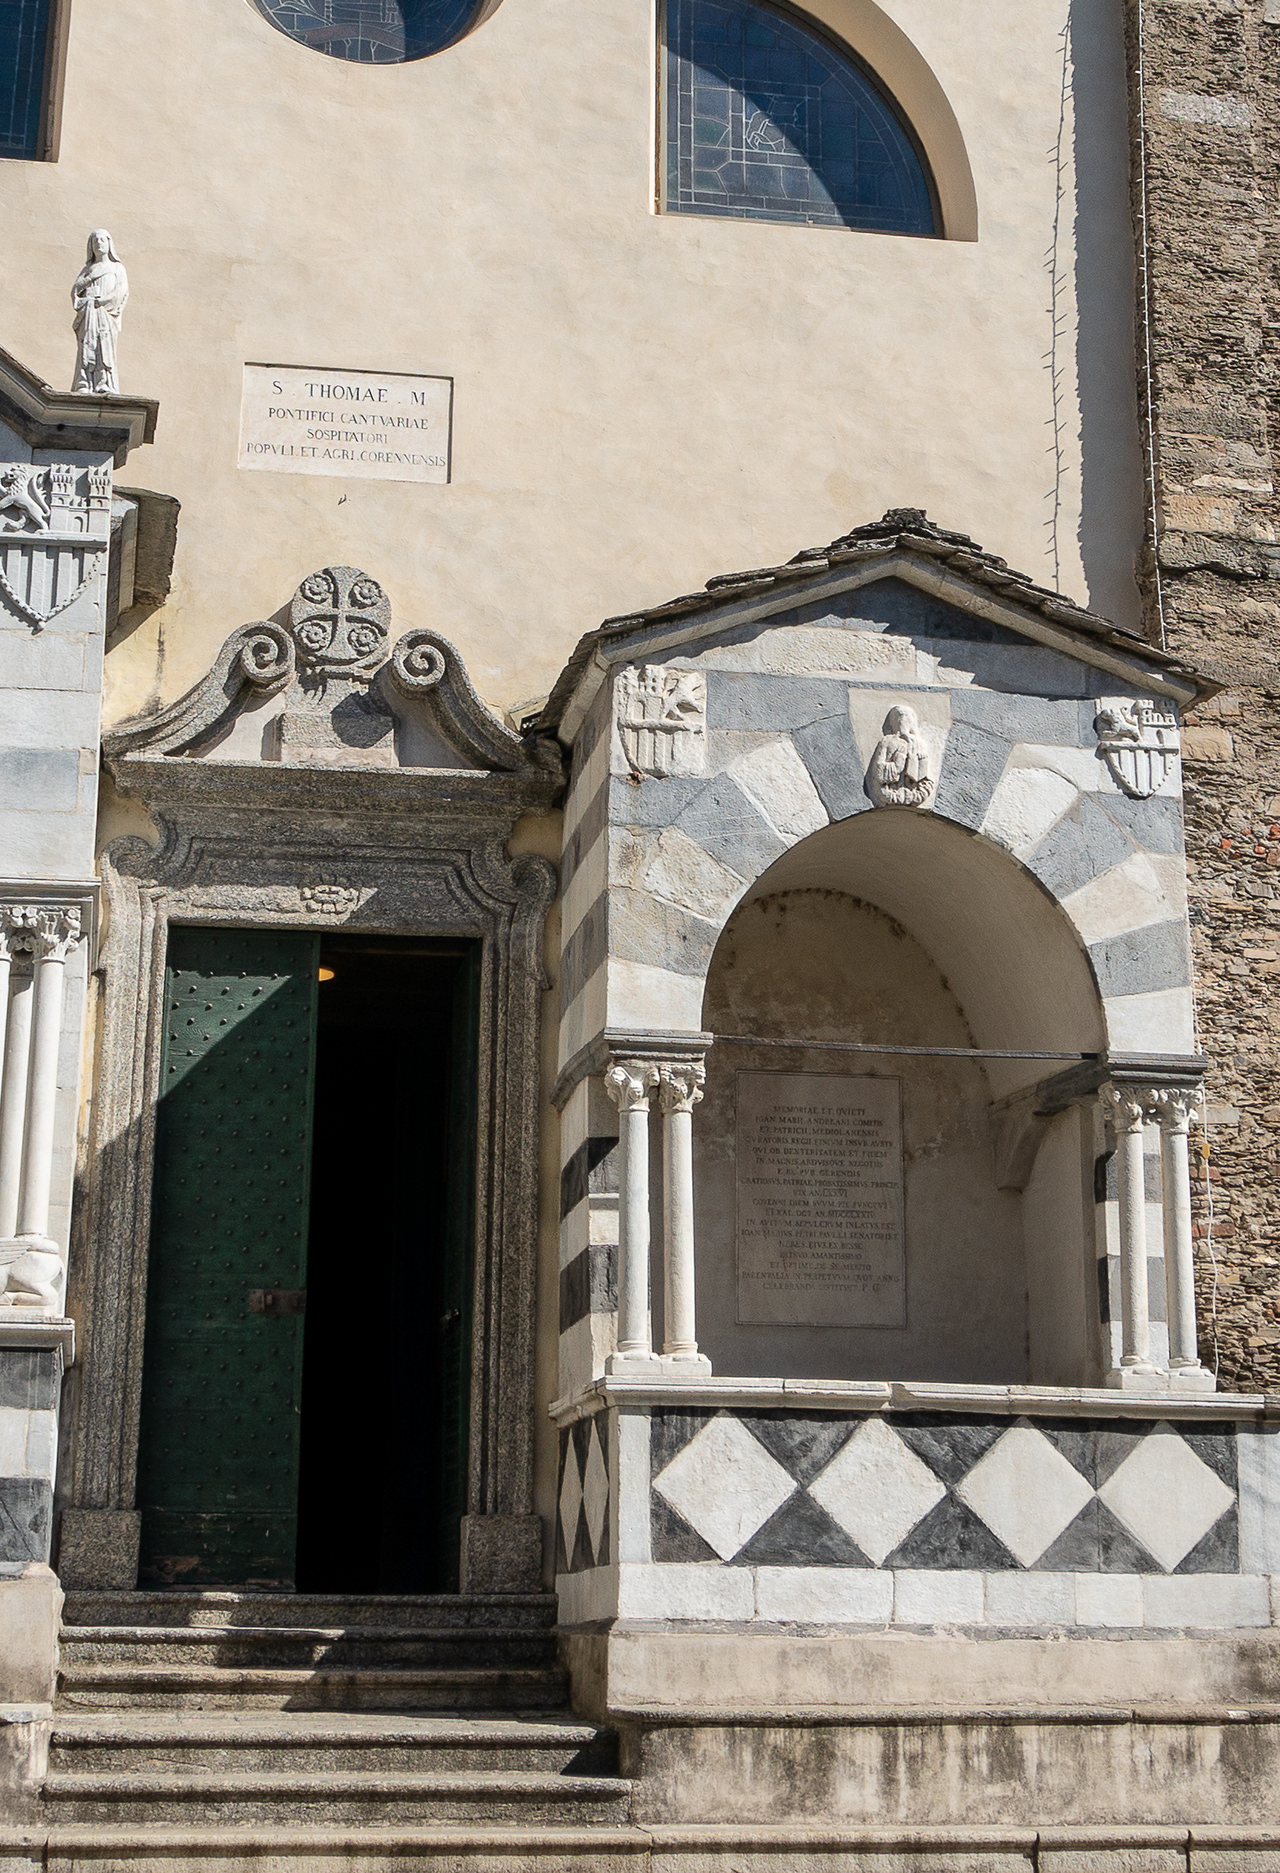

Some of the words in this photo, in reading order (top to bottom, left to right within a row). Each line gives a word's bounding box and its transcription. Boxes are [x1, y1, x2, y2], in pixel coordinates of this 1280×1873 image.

[272, 380, 283, 395] S
[304, 383, 388, 403] THOMAE
[410, 391, 425, 406] M
[268, 407, 334, 422] PONTIFICI
[340, 413, 429, 429] CANTVARIAE
[307, 429, 388, 444] SOSPITATORI
[247, 443, 294, 456] POPVLI
[301, 447, 319, 458] ET
[836, 1108, 866, 1116] QVIETI
